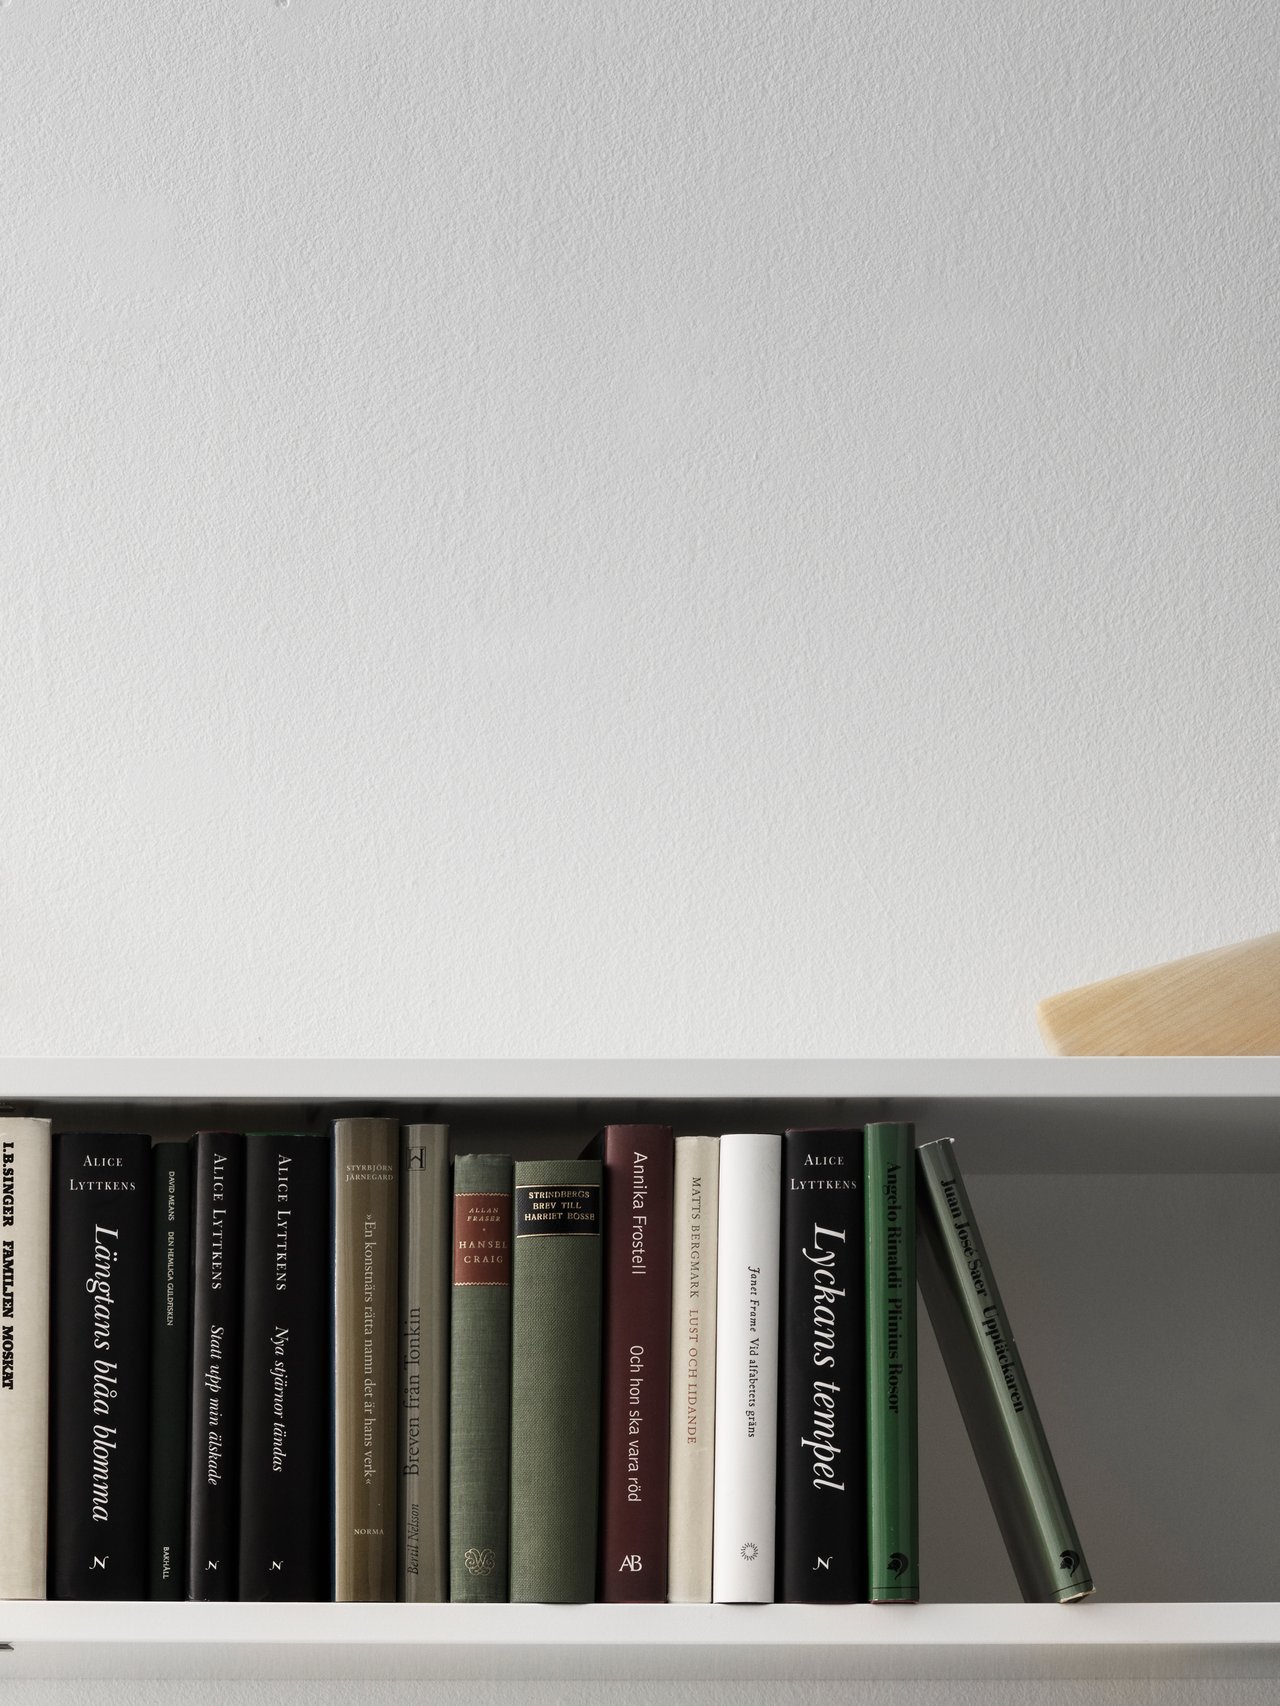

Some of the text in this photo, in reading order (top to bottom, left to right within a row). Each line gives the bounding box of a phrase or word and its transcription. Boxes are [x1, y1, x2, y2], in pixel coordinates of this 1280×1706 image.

[167, 1171, 176, 1221] DAVID MEANS
[524, 1212, 595, 1222] HARRIET BOSSE
[528, 1190, 590, 1200] STRINDBERGS
[532, 1201, 557, 1210] BREV
[631, 1151, 648, 1274] Annika Frostell
[2, 1240, 15, 1319] FAMILJEN
[166, 1231, 175, 1326] DEN HEMLIGA GULDFISKEN
[364, 1242, 377, 1303] konstnärs
[458, 1240, 508, 1249] HANSEL
[463, 1254, 504, 1264] CRAIG
[364, 1306, 376, 1335] rätta
[687, 1176, 702, 1444] MATTS BERGMARK LUST OCH LIDANDE
[881, 1161, 903, 1414] Angelo Rinaldi Plinius Rosor
[940, 1178, 1025, 1413] Juan José Saer Upptäckaren
[1, 1325, 14, 1390] MOSKAT
[85, 1223, 119, 1522] Längtans blåa blomma
[364, 1339, 373, 1374] namn
[746, 1265, 761, 1438] Janet Frame Vid alfabetets gräns
[800, 1222, 846, 1491] Lyckans tempel
[204, 1324, 224, 1486] Statt upp min älskade
[269, 1326, 289, 1472] Nya stjärnor tändas
[363, 1401, 376, 1415] är
[364, 1378, 377, 1398] det
[403, 1308, 421, 1476] Breven från Tonkin
[627, 1345, 645, 1502] Och hon ska vara röd
[363, 1418, 377, 1447] hans
[406, 1503, 420, 1575] Bertil Nelsson
